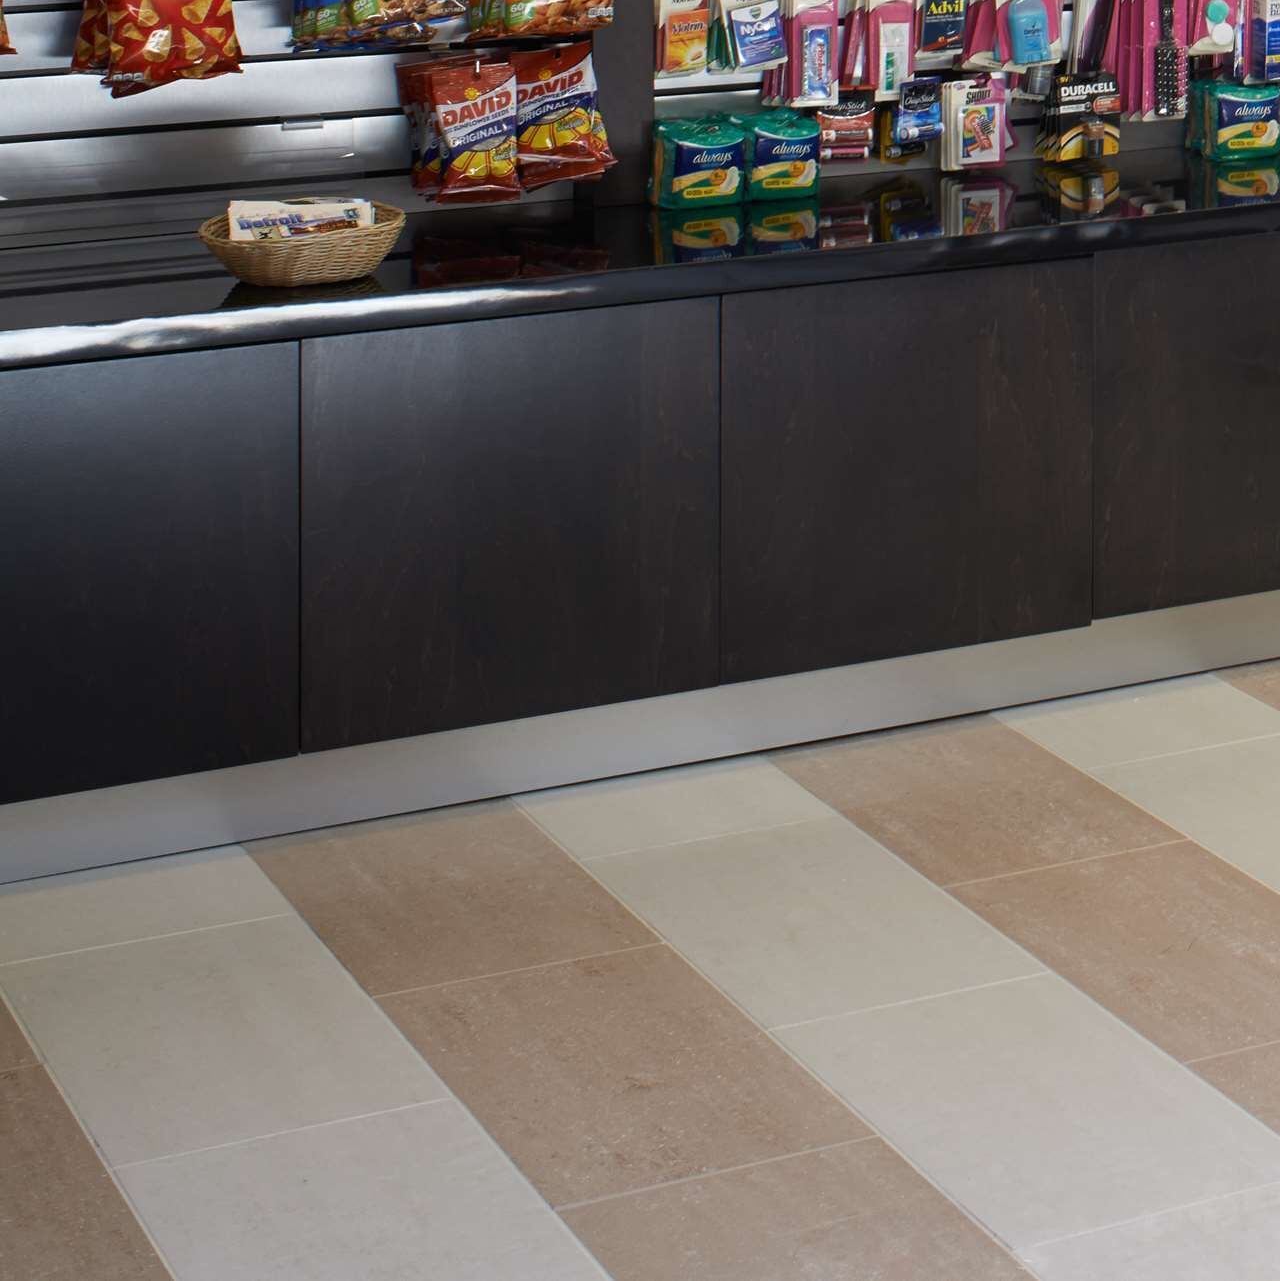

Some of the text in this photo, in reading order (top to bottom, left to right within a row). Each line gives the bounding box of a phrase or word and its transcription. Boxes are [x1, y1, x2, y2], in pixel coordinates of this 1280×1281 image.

[516, 69, 585, 104] DAVID
[1061, 80, 1117, 98] DURACELL
[441, 89, 512, 126] DAVID
[1235, 102, 1273, 118] always
[692, 148, 735, 166] always
[772, 140, 815, 156] always
